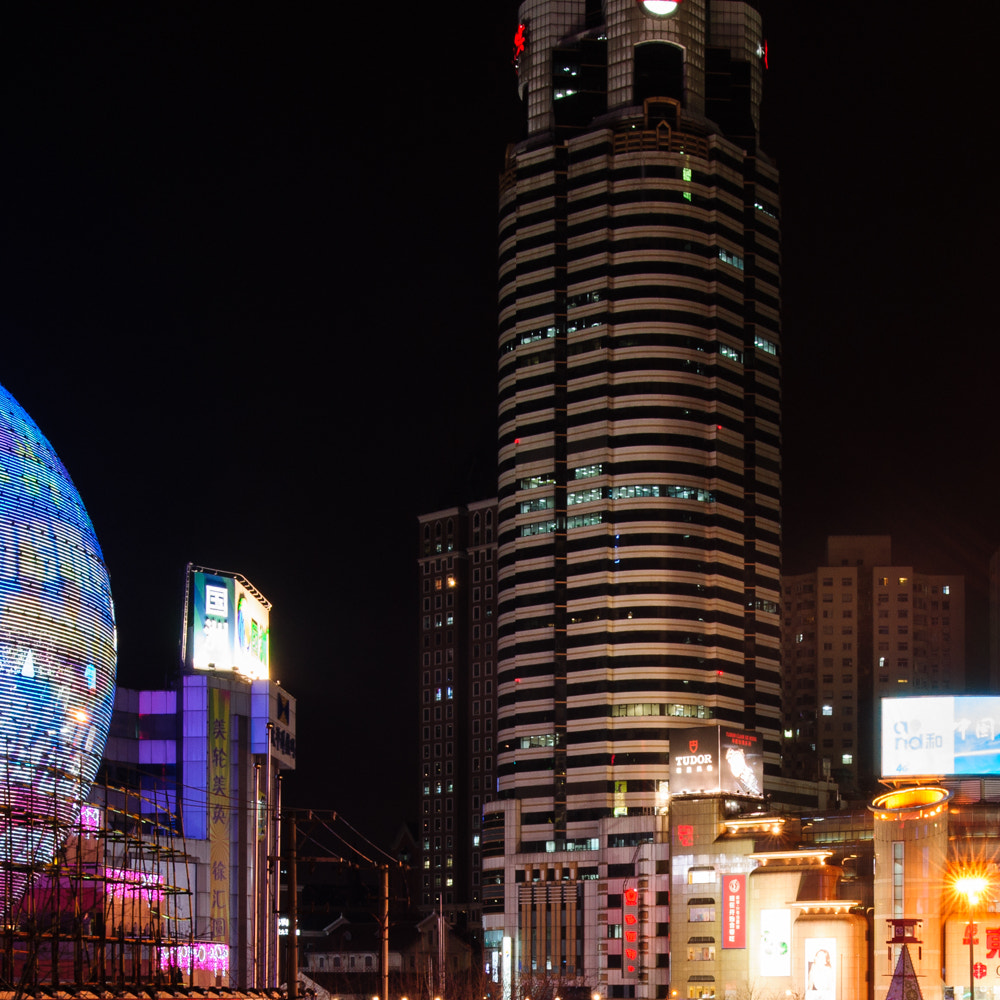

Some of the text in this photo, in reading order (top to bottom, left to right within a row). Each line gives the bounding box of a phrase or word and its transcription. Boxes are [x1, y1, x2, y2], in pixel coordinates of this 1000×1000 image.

[212, 719, 227, 824] 美轮美奂
[675, 754, 712, 766] TUDOR
